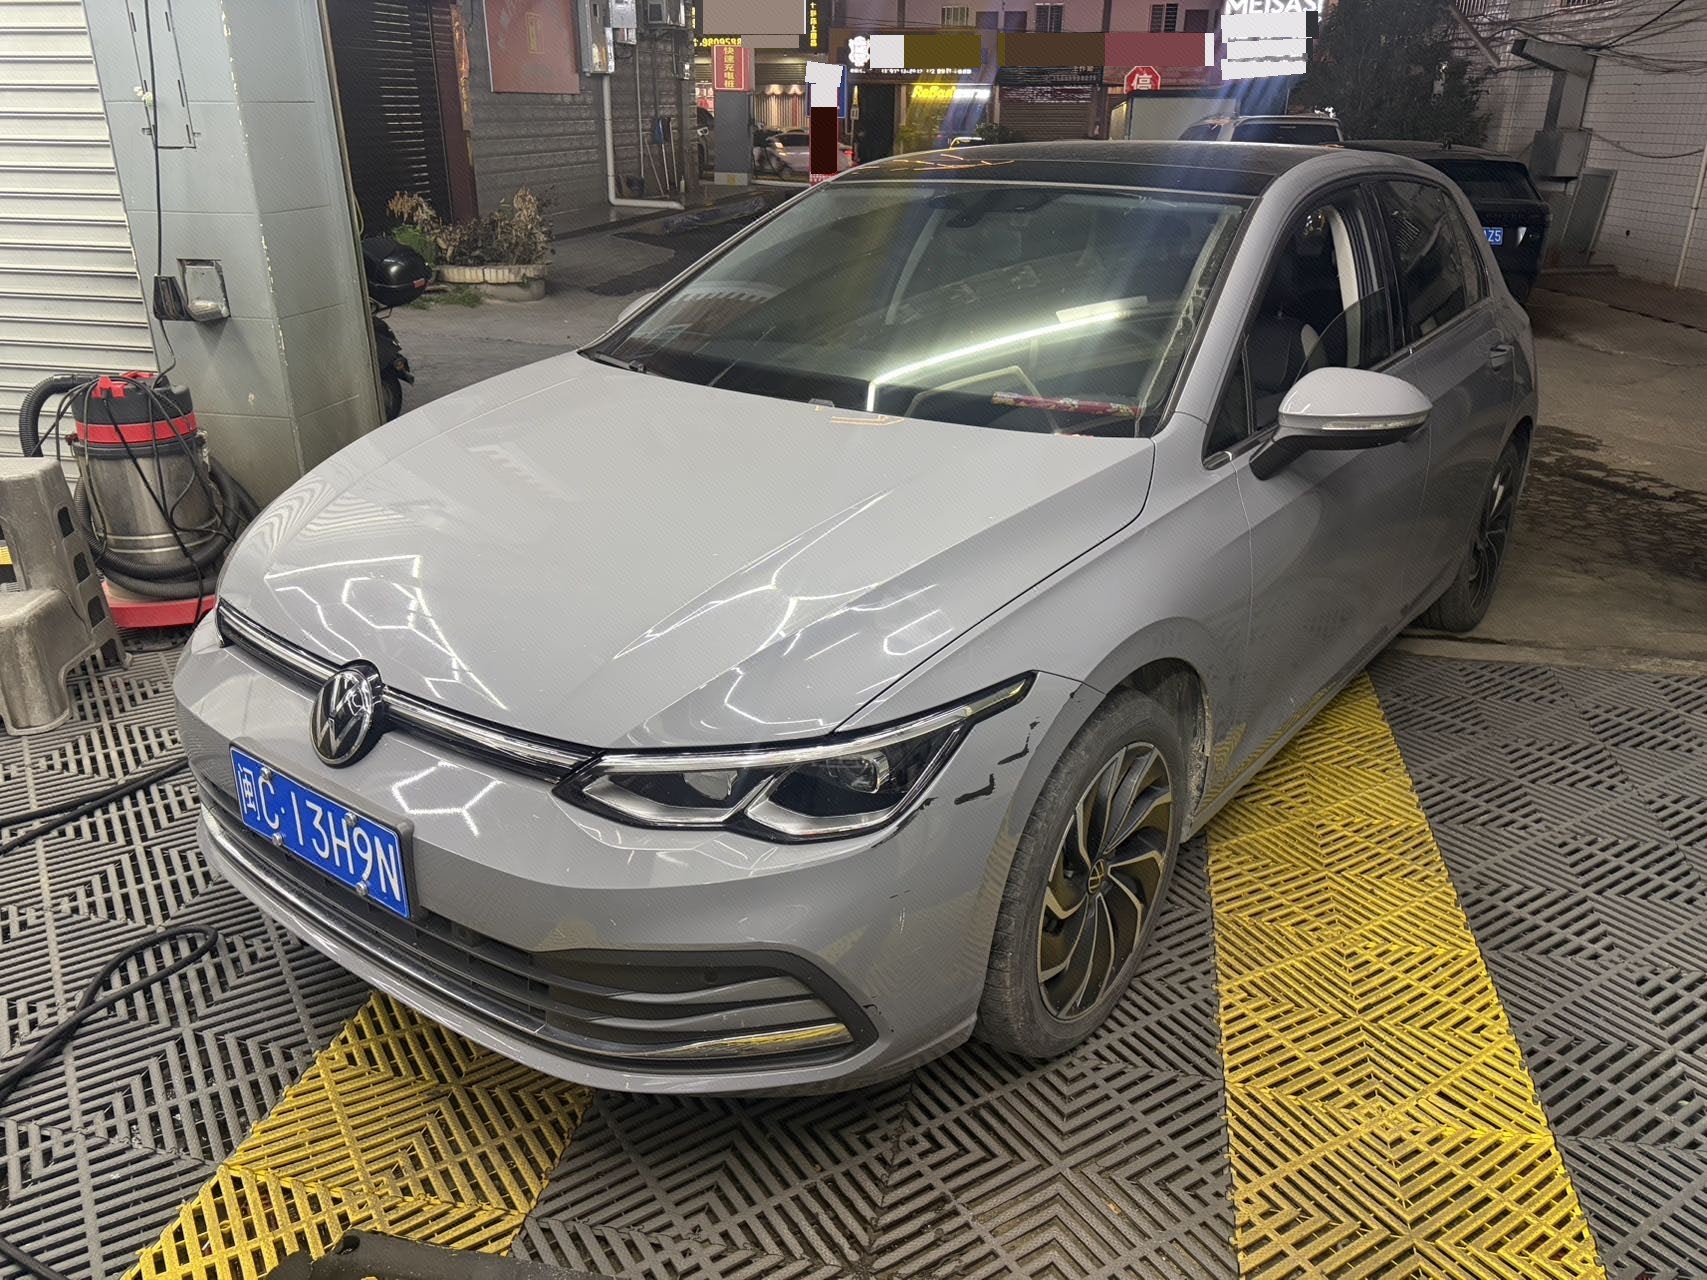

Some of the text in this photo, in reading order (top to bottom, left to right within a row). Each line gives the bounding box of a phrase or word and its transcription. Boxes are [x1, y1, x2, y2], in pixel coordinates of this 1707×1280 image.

[723, 46, 736, 88] 快速充电桩
